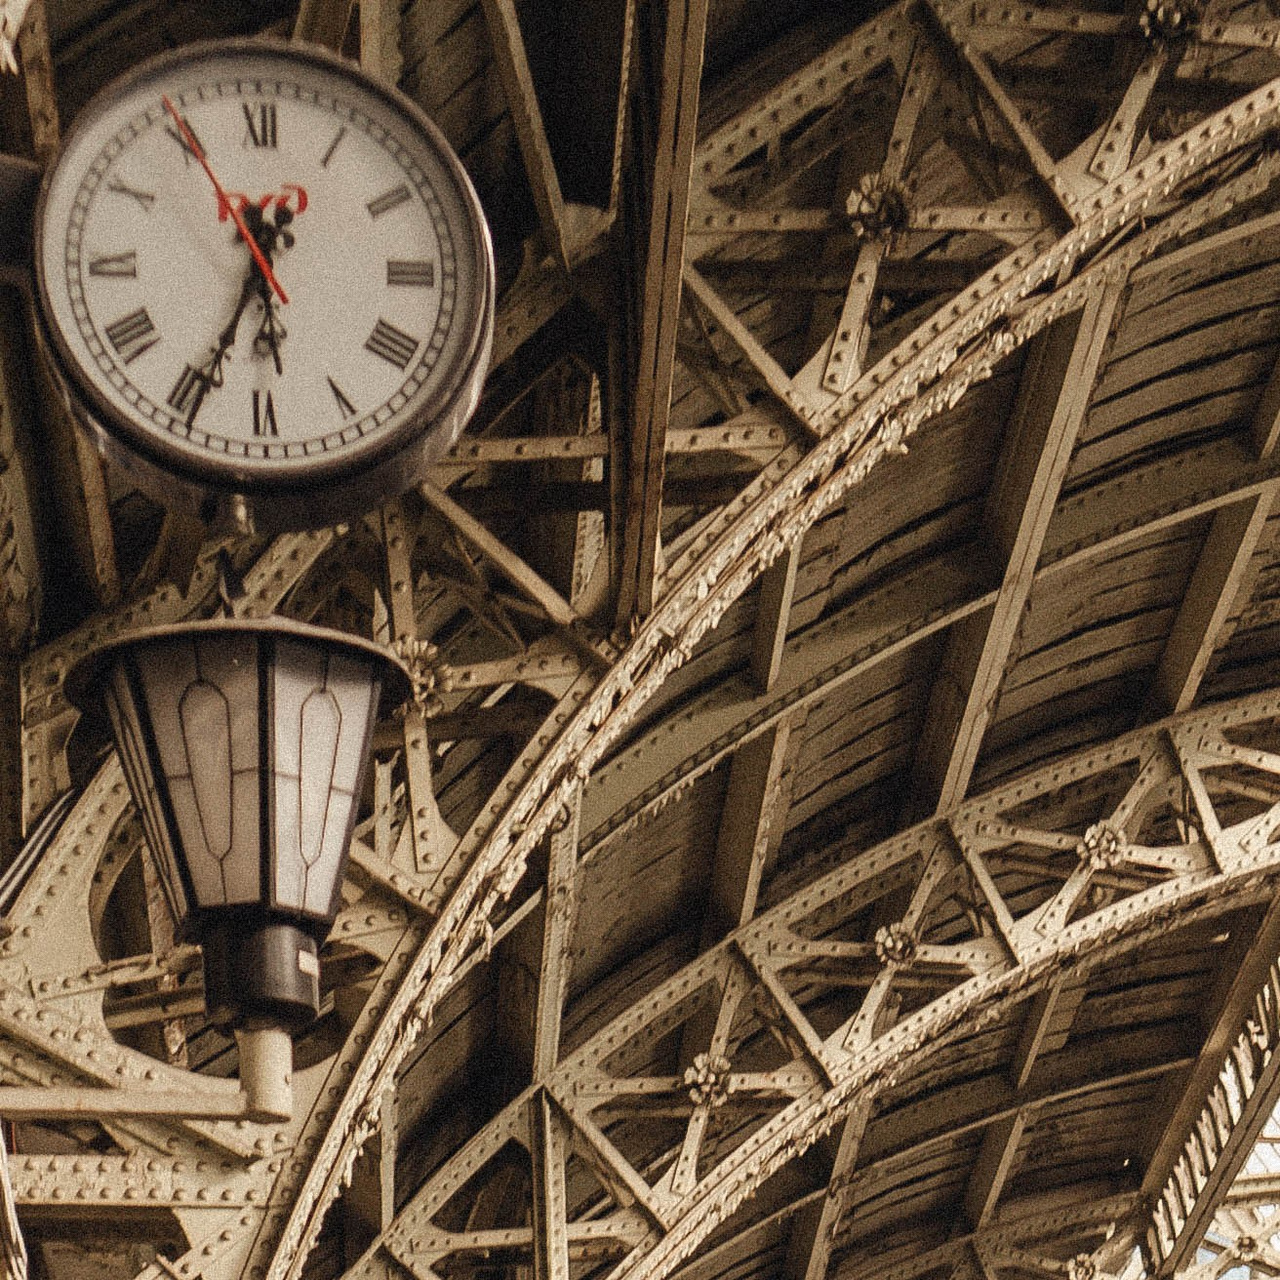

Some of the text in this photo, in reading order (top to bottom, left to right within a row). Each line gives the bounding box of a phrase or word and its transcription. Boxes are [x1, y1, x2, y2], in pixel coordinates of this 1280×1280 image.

[243, 103, 278, 149] XII
[107, 179, 155, 211] X
[366, 182, 414, 218] II
[89, 251, 137, 278] IX
[387, 260, 434, 288] III
[104, 306, 161, 365] VIII
[251, 389, 279, 437] VI
[326, 375, 357, 419] V
